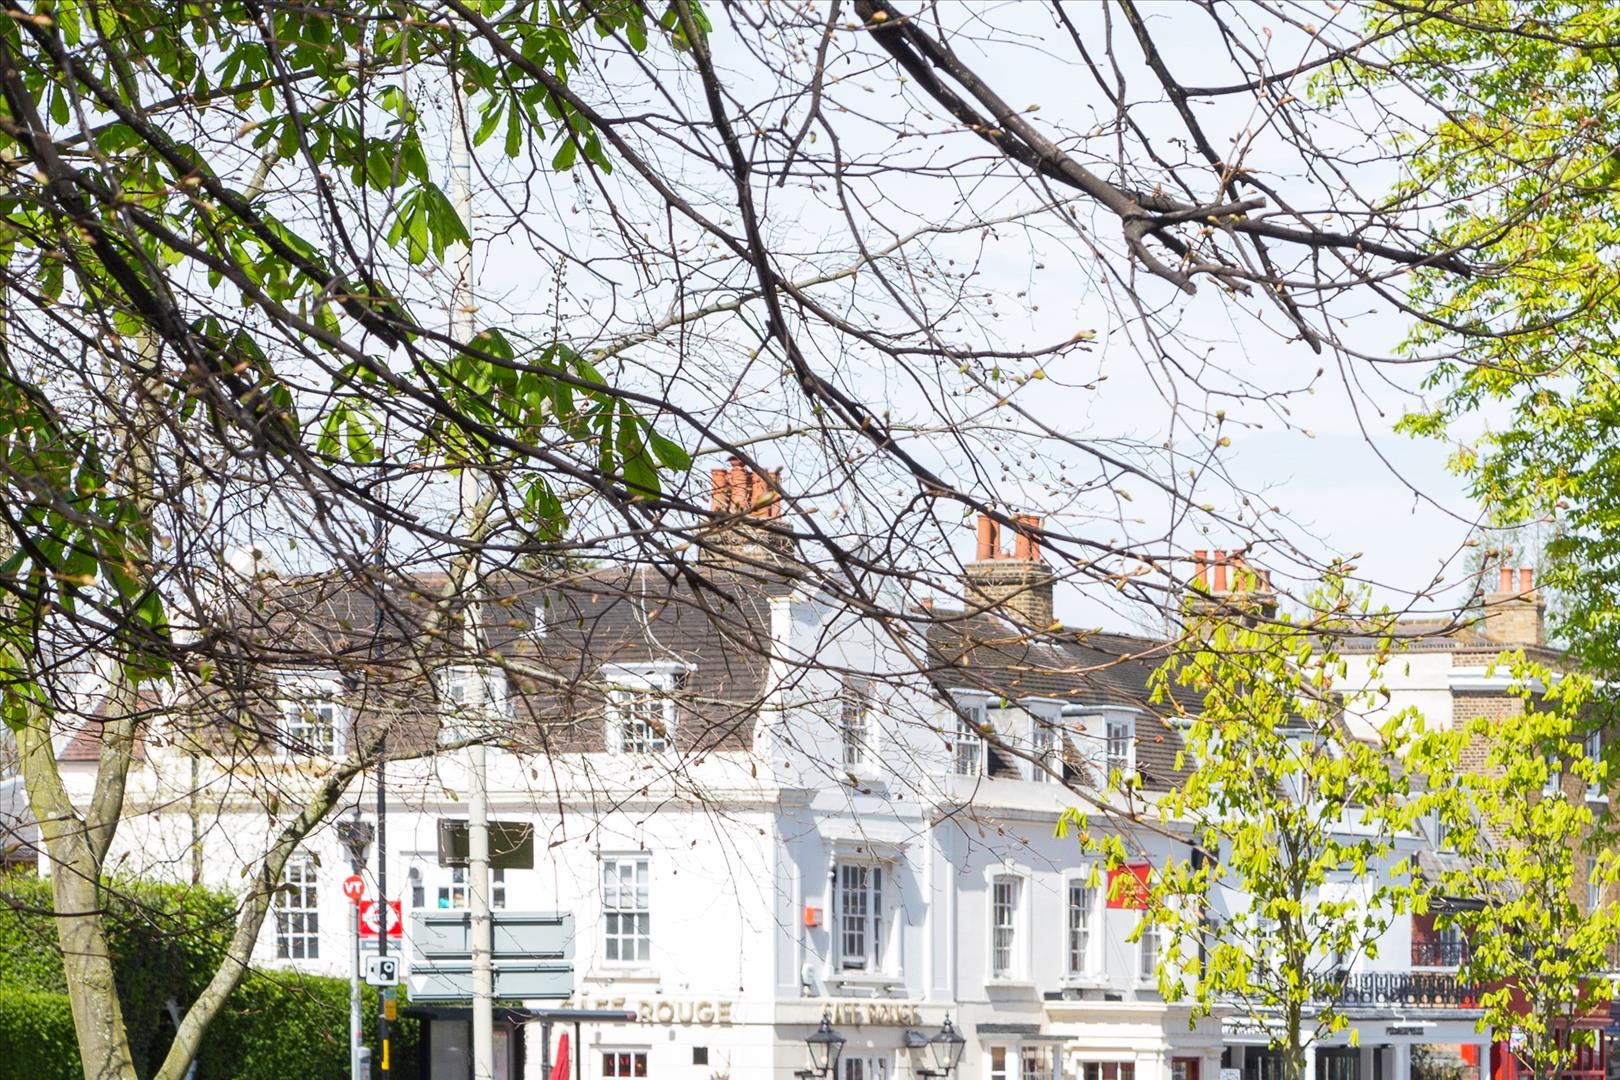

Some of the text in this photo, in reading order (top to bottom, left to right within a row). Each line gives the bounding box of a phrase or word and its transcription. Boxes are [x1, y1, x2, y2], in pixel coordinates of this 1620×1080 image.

[344, 881, 363, 894] VT
[639, 1000, 732, 1025] ROUGE
[867, 1003, 919, 1025] ROUGE
